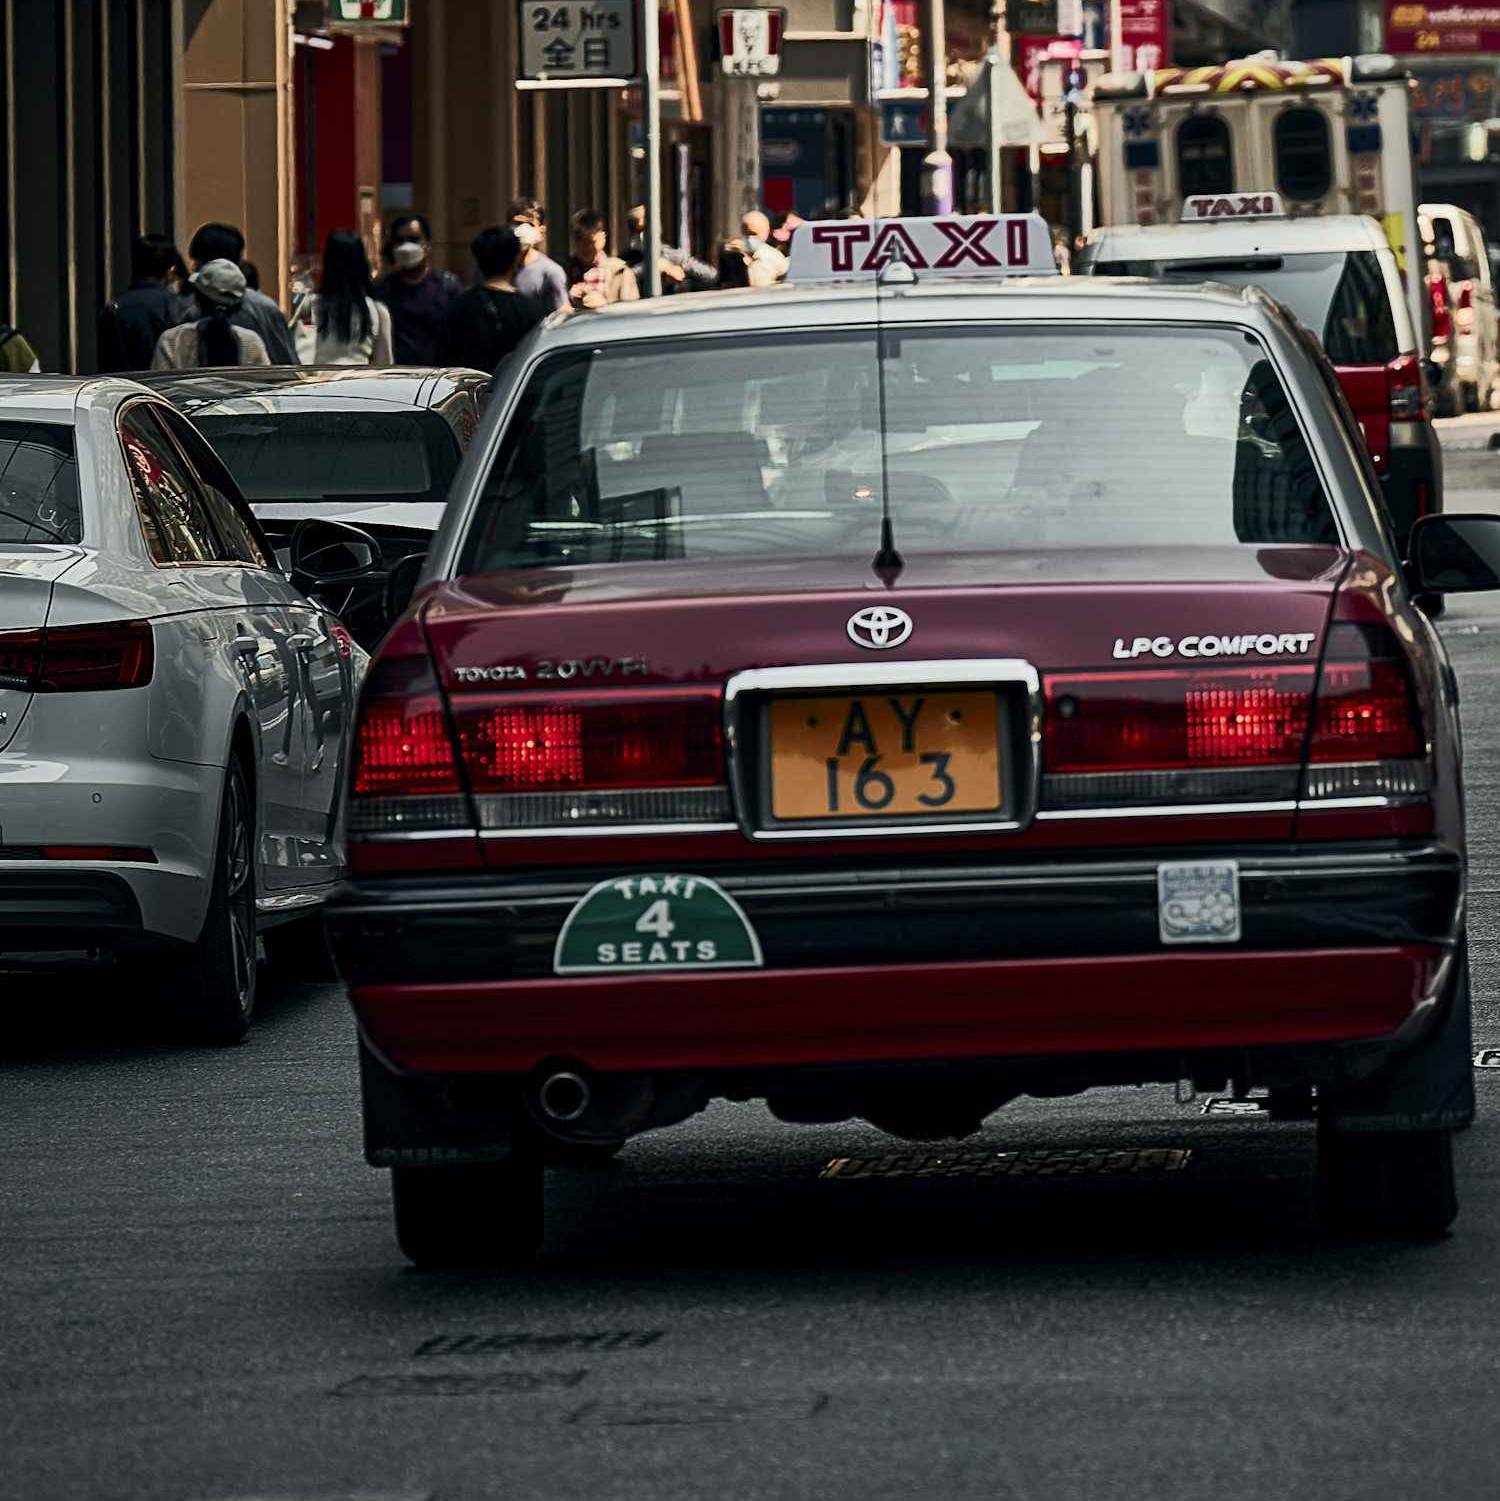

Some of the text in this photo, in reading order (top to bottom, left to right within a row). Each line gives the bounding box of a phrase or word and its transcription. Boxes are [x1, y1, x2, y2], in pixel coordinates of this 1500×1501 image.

[531, 7, 620, 31] 24 hrs
[542, 36, 610, 70] 全日
[1190, 194, 1274, 218] TAXI
[812, 218, 1030, 273] TAXI
[1112, 632, 1316, 659] LPG COMFORT
[454, 665, 528, 683] TOYOTA
[836, 699, 926, 756] AY
[826, 752, 956, 812] 163
[614, 875, 697, 900] TAXI
[635, 899, 675, 939] 4
[597, 940, 717, 973] SEATS
